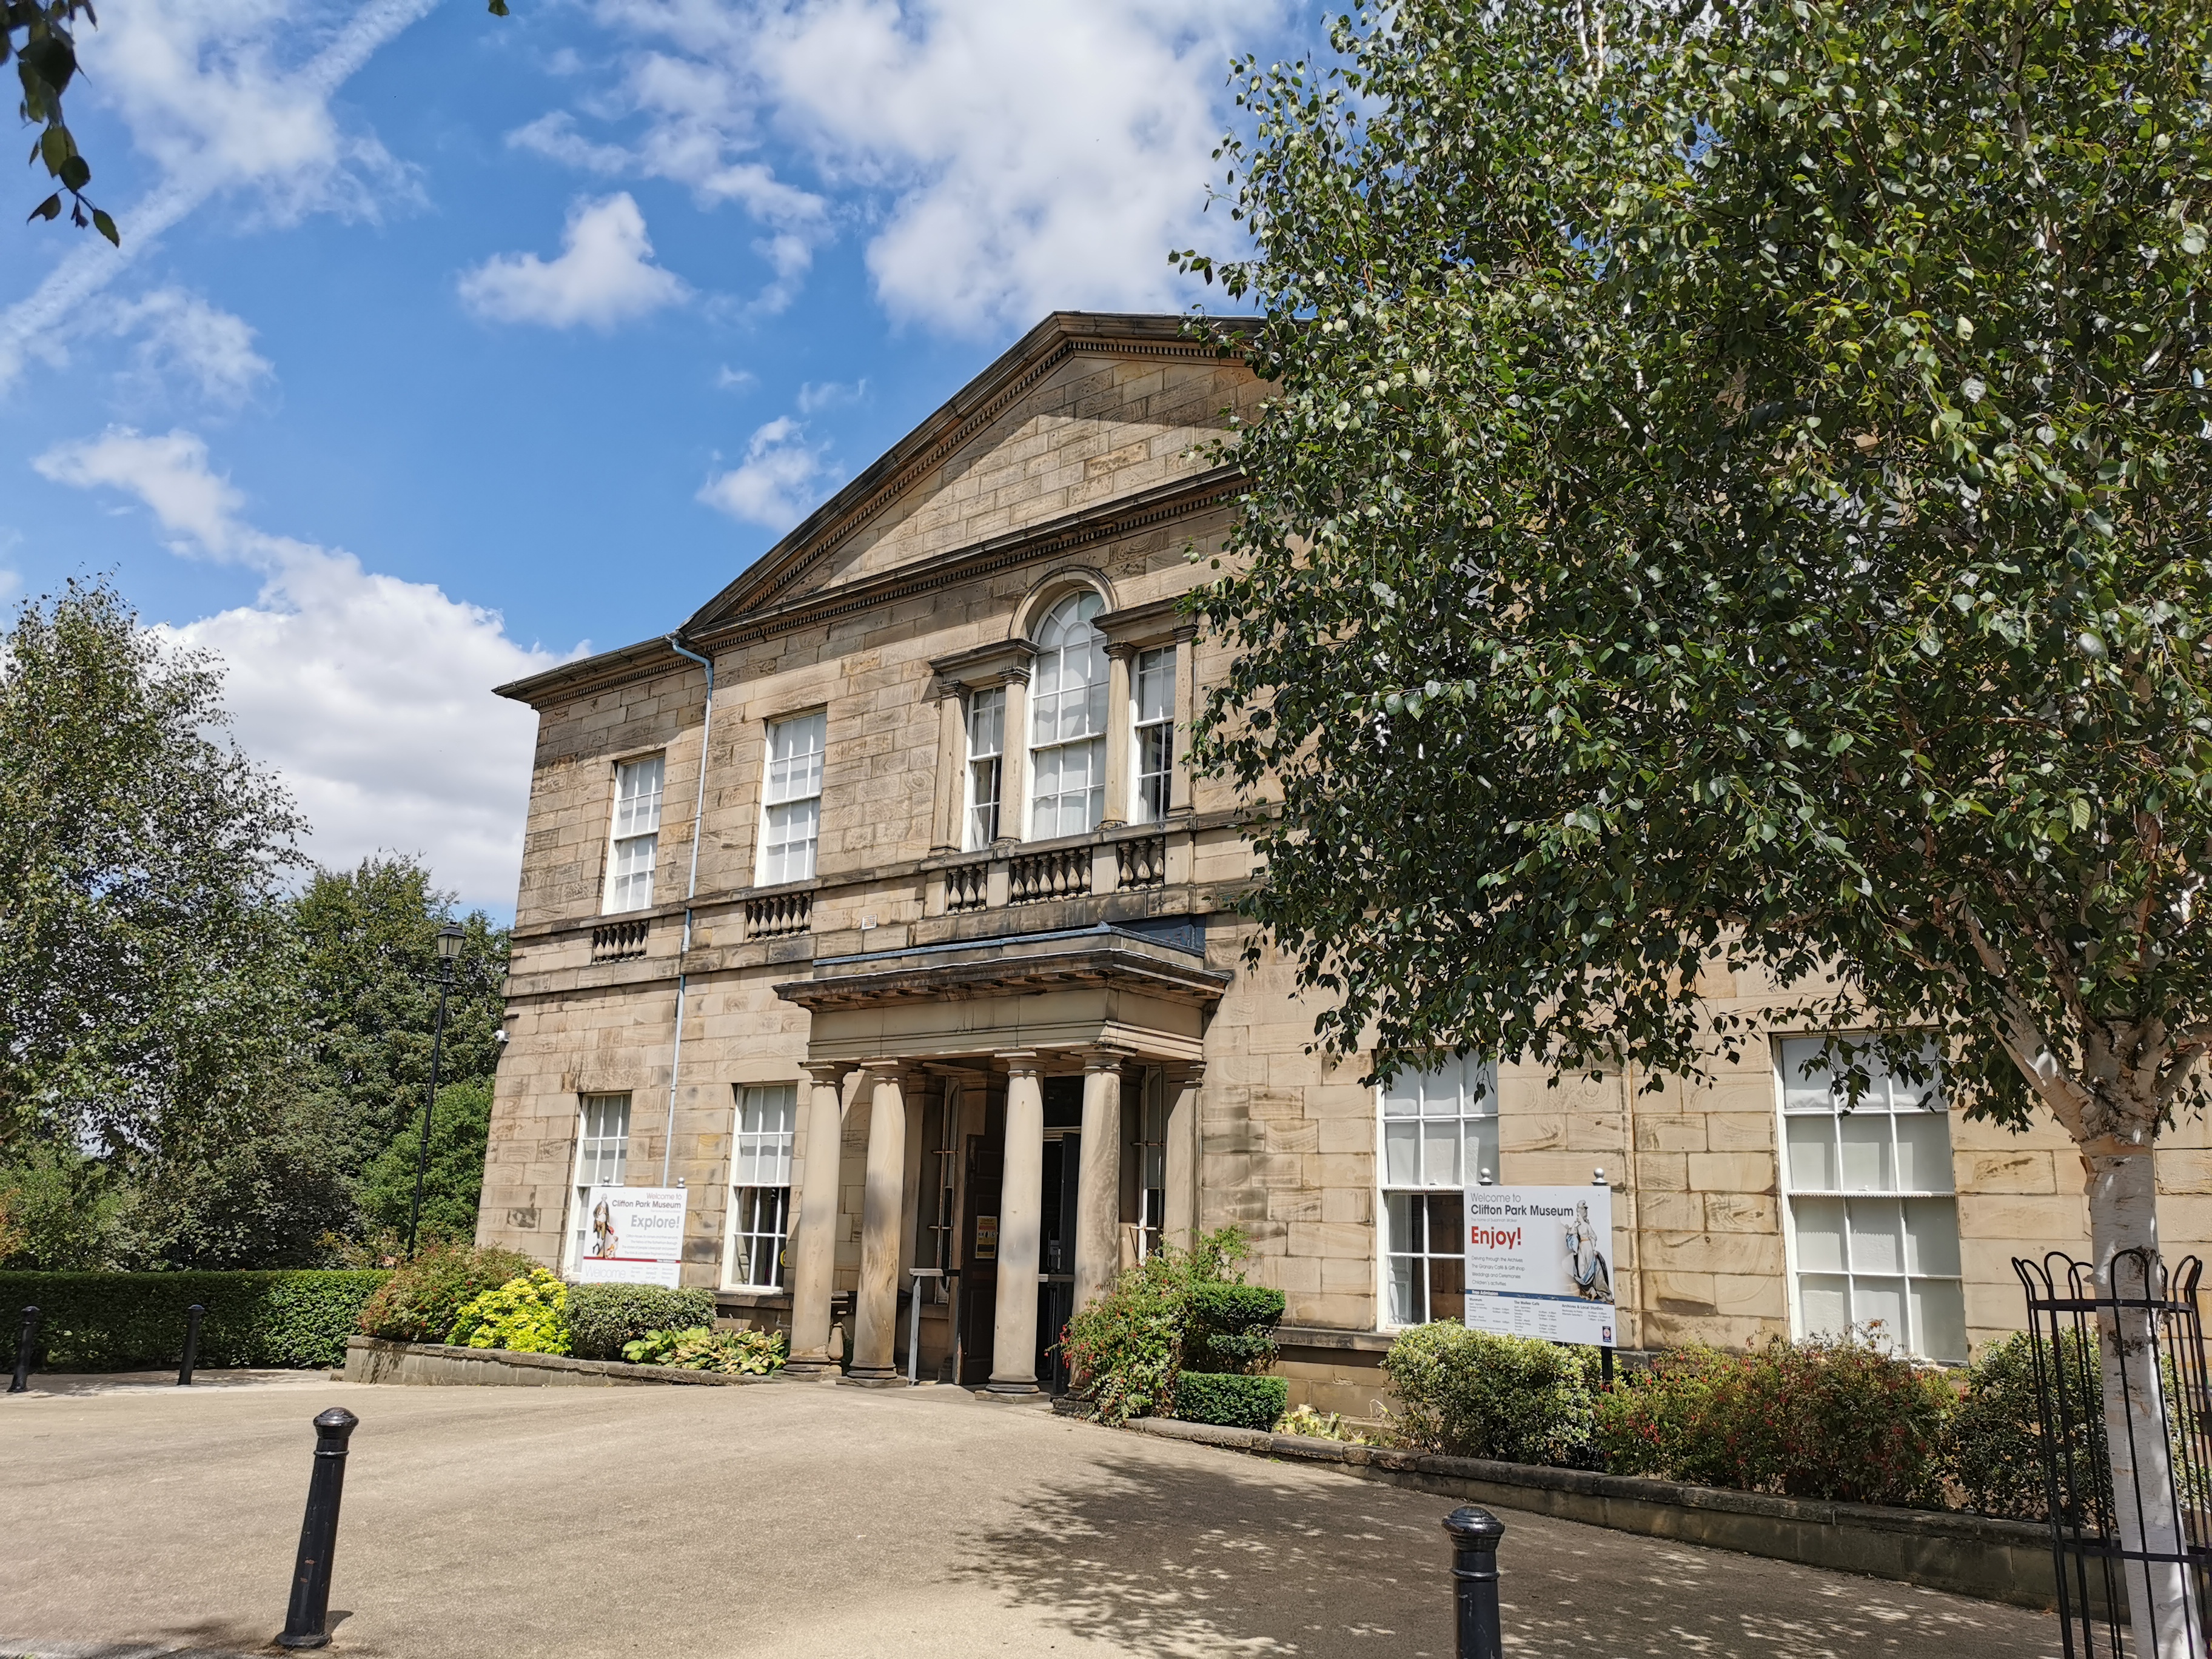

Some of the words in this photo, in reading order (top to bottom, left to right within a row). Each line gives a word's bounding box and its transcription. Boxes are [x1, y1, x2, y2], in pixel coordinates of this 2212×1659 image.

[1470, 1193, 1510, 1202] Welcome
[1512, 1193, 1521, 1202] to
[1471, 1204, 1501, 1215] Clifton
[1505, 1205, 1527, 1216] Park
[1530, 1205, 1574, 1216] Museum
[631, 1215, 680, 1230] Explore!
[1472, 1226, 1521, 1249] Enjoy!
[585, 1265, 626, 1278] Welcome
